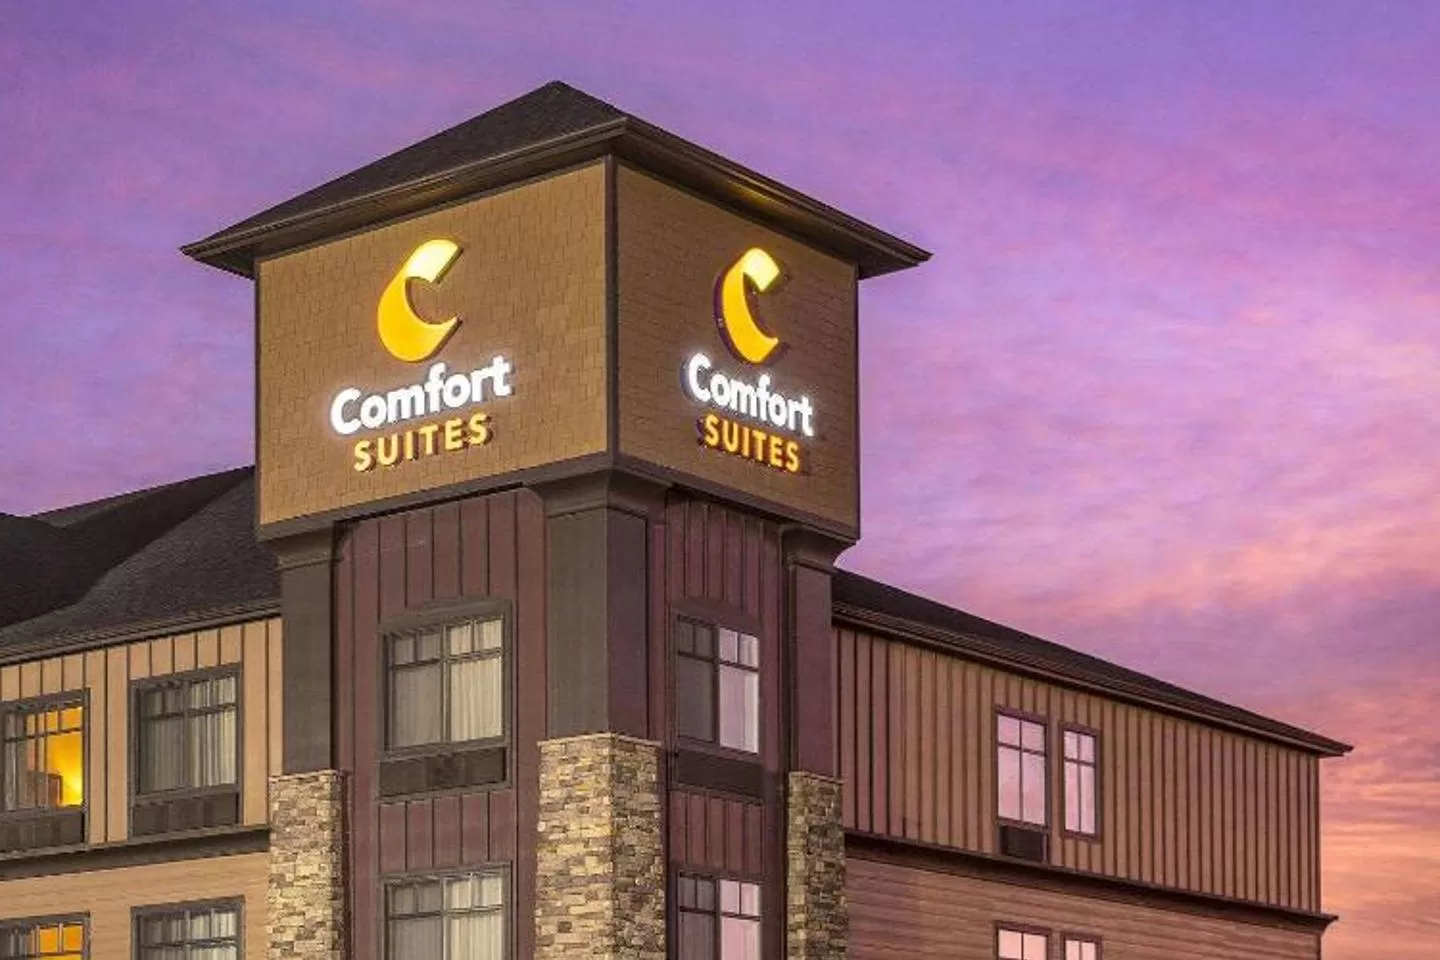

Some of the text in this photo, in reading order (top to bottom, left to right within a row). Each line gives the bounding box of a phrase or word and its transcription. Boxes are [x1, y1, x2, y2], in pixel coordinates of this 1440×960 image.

[330, 355, 512, 435] Comfort
[688, 352, 814, 437] Comfort
[353, 412, 488, 473] SUITES
[704, 413, 800, 473] SUITES
